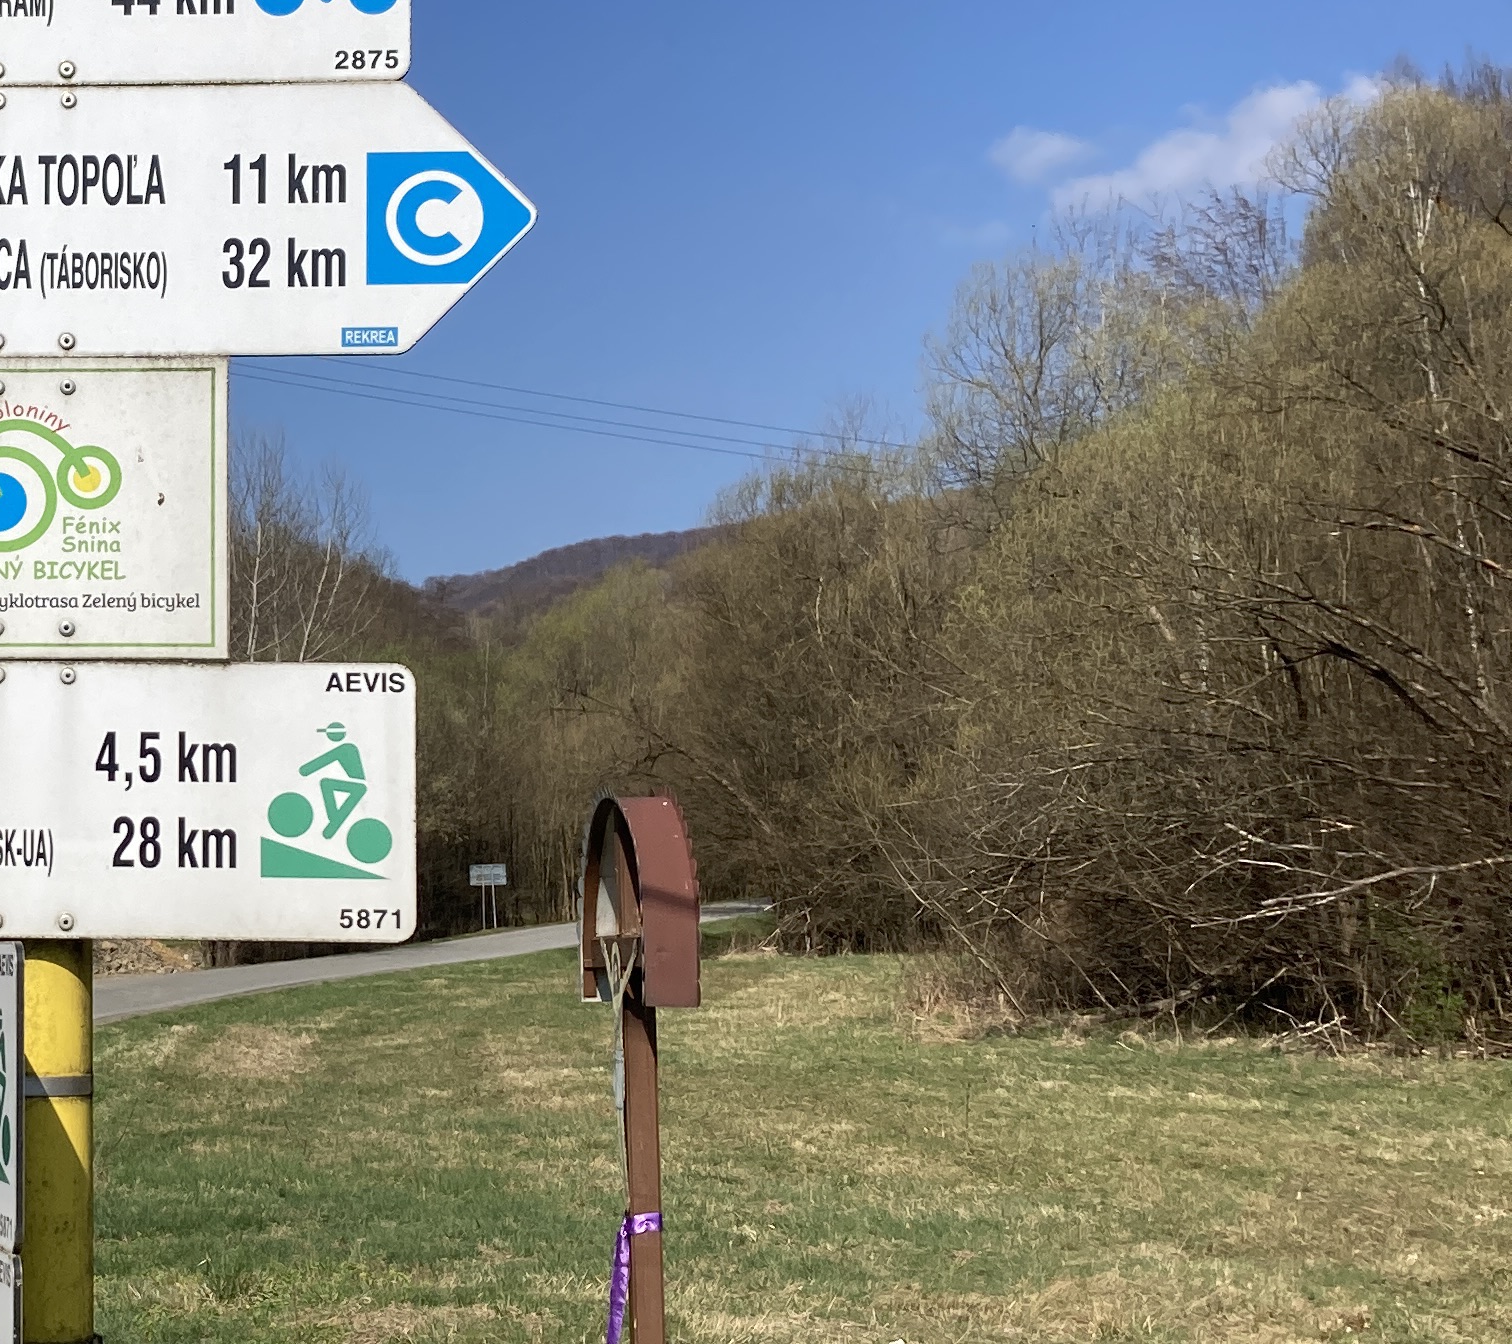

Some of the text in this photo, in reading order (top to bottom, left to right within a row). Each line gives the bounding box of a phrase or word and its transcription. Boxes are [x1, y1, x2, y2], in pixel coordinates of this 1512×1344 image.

[335, 50, 398, 69] 2875
[39, 154, 165, 206] TOPOĽA
[224, 154, 266, 204] 11
[288, 154, 346, 203] km
[41, 245, 167, 298] (TÁBORISKO)
[222, 238, 270, 288] 32
[288, 238, 345, 287] km
[345, 330, 395, 344] REKREA
[62, 516, 120, 534] Fénix
[62, 536, 120, 553] Snina
[33, 561, 126, 580] BICYKEL
[83, 593, 136, 612] Zelený
[141, 593, 199, 612] bicykel
[326, 673, 404, 692] AEVIS
[96, 732, 161, 791] 4,5
[179, 732, 236, 782] km
[113, 817, 160, 868] 28
[179, 817, 236, 868] km
[340, 909, 400, 929] 5871
